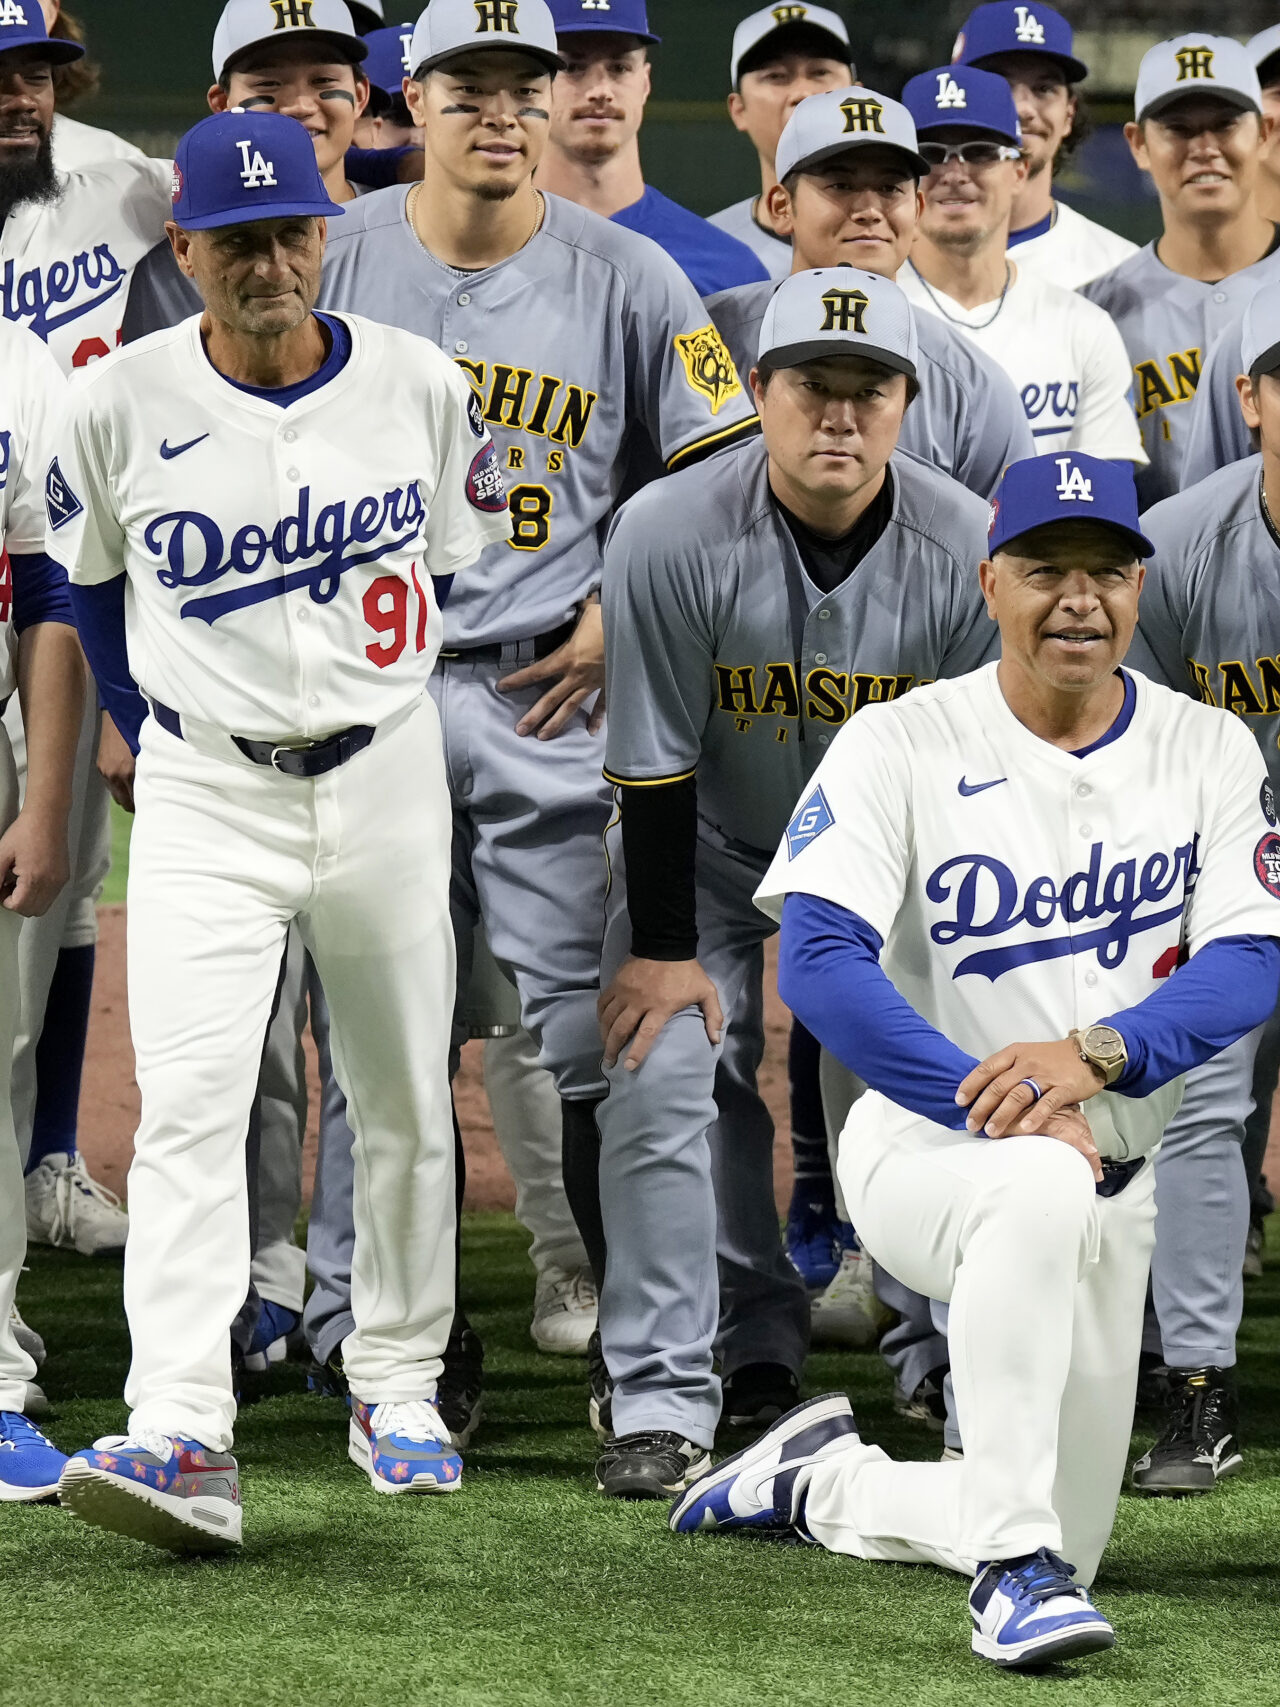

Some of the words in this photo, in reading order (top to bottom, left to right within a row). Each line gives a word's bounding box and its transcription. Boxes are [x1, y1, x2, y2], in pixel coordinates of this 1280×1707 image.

[1014, 6, 1045, 44] LA
[935, 73, 967, 108] LA
[235, 140, 278, 188] LA
[1055, 458, 1094, 502] LA
[145, 481, 426, 604] Dodgers
[361, 561, 427, 669] 91
[798, 805, 821, 832] G
